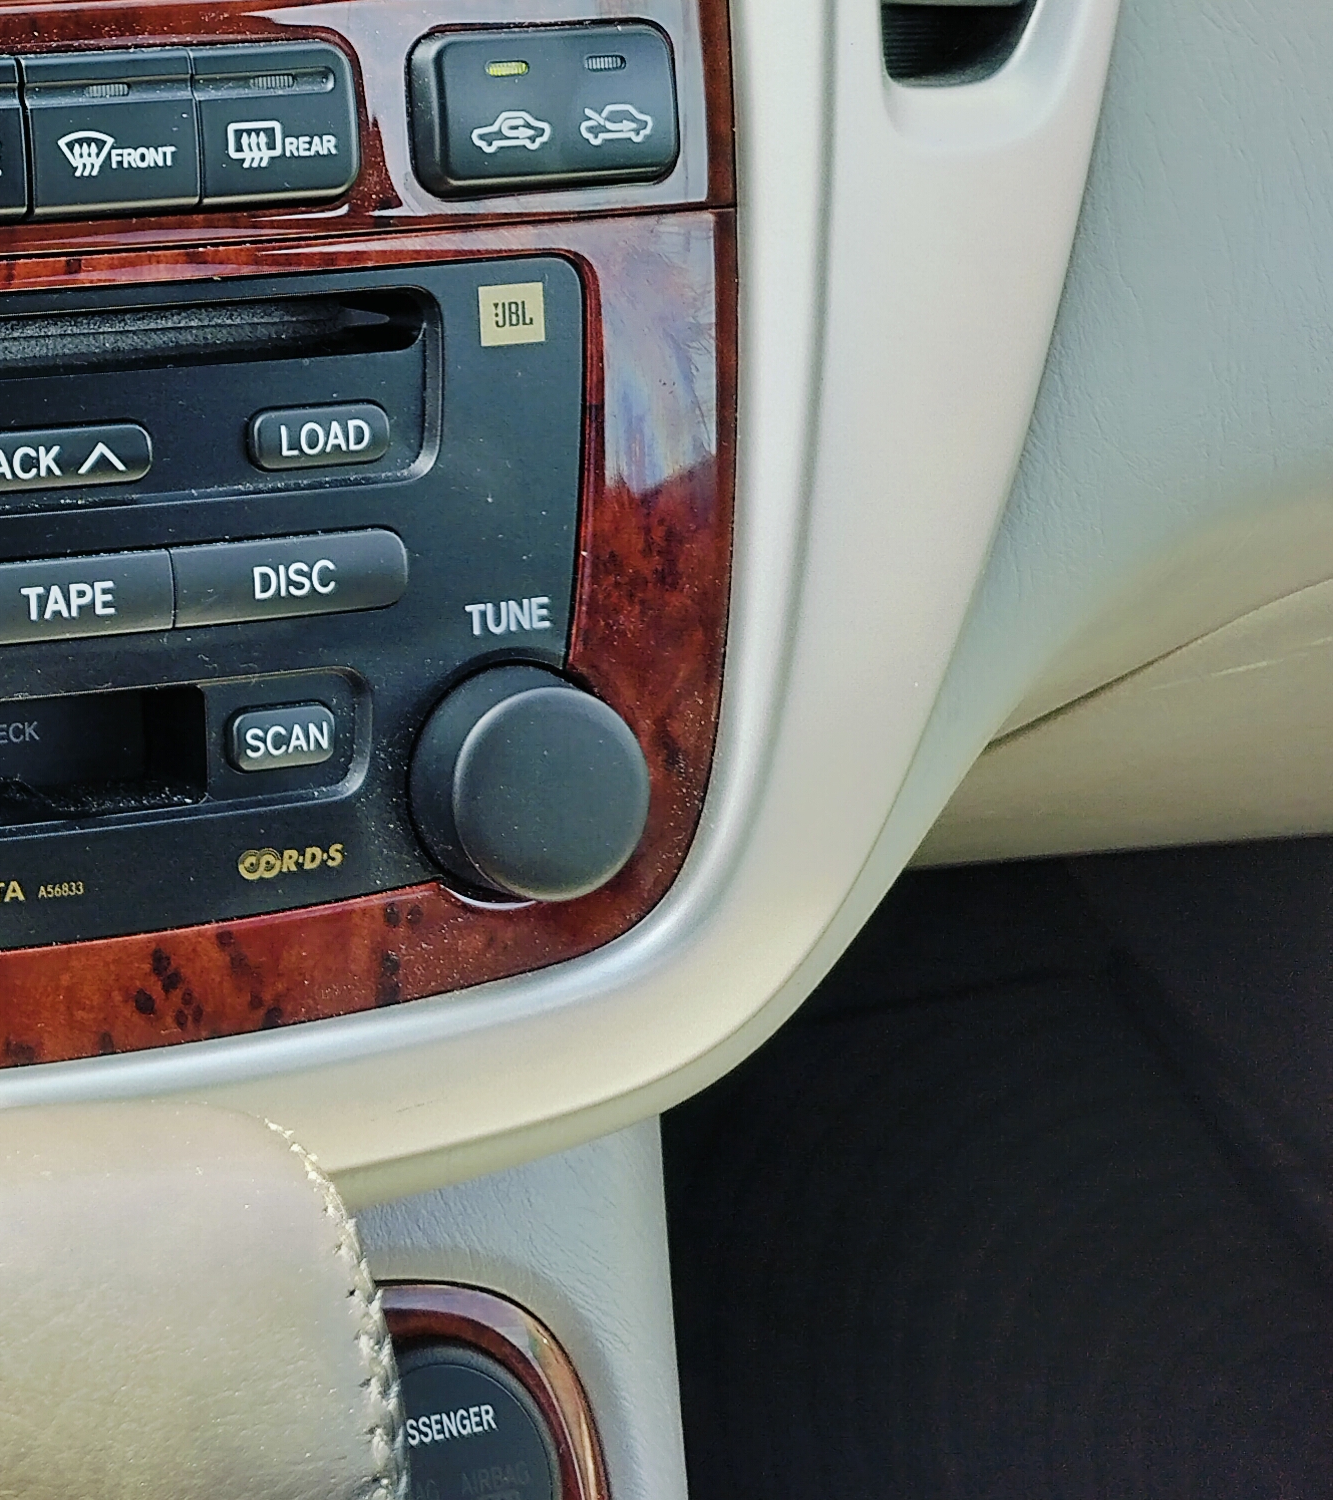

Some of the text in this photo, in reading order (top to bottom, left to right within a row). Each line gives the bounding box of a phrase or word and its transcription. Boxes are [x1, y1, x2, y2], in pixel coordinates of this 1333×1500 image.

[110, 145, 176, 170] FRONT
[284, 135, 337, 159] REAR
[492, 300, 534, 329] JBL
[279, 418, 371, 457] LOAD
[252, 558, 337, 600] DISC
[20, 580, 117, 622] TAPE
[463, 595, 552, 637] TUNE
[244, 719, 331, 758] SCAN
[37, 880, 85, 900] A56833
[405, 1403, 500, 1447] SSENGER
